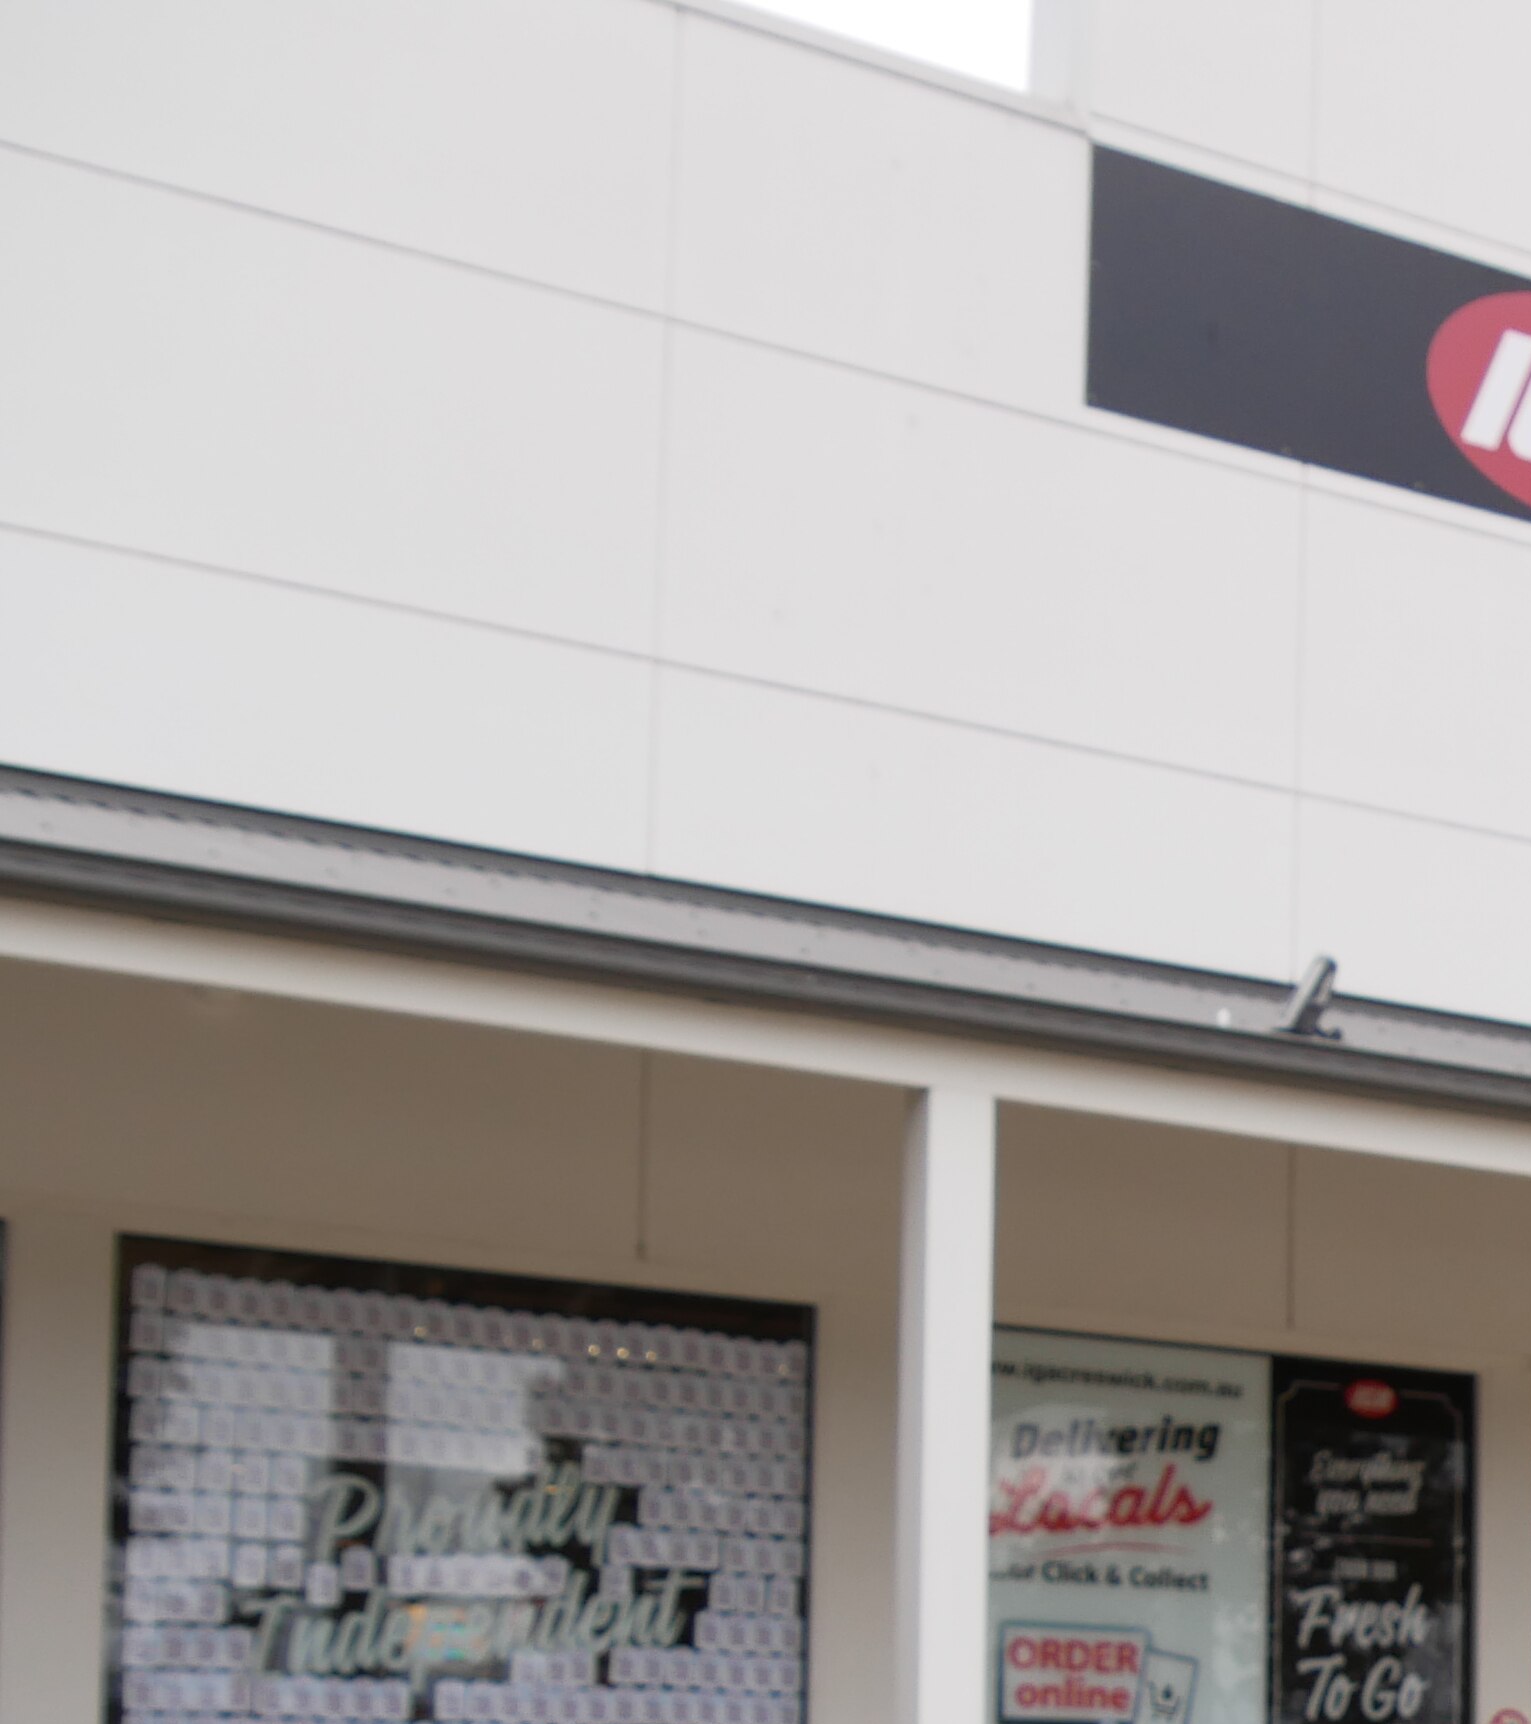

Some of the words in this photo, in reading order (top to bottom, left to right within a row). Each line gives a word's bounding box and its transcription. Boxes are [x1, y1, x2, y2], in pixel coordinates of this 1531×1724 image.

[1012, 1412, 1221, 1464] Delivering
[303, 1460, 622, 1566] Proudly
[989, 1462, 1214, 1535] Locals
[1041, 1558, 1098, 1585] Click
[1104, 1562, 1122, 1586] &
[1129, 1565, 1209, 1592] Collect
[240, 1563, 708, 1706] Independent
[1288, 1581, 1428, 1650] Fresh
[1006, 1636, 1139, 1675] ORDER
[1296, 1654, 1355, 1722] To
[1360, 1655, 1429, 1721] Go
[1013, 1676, 1131, 1711] online
